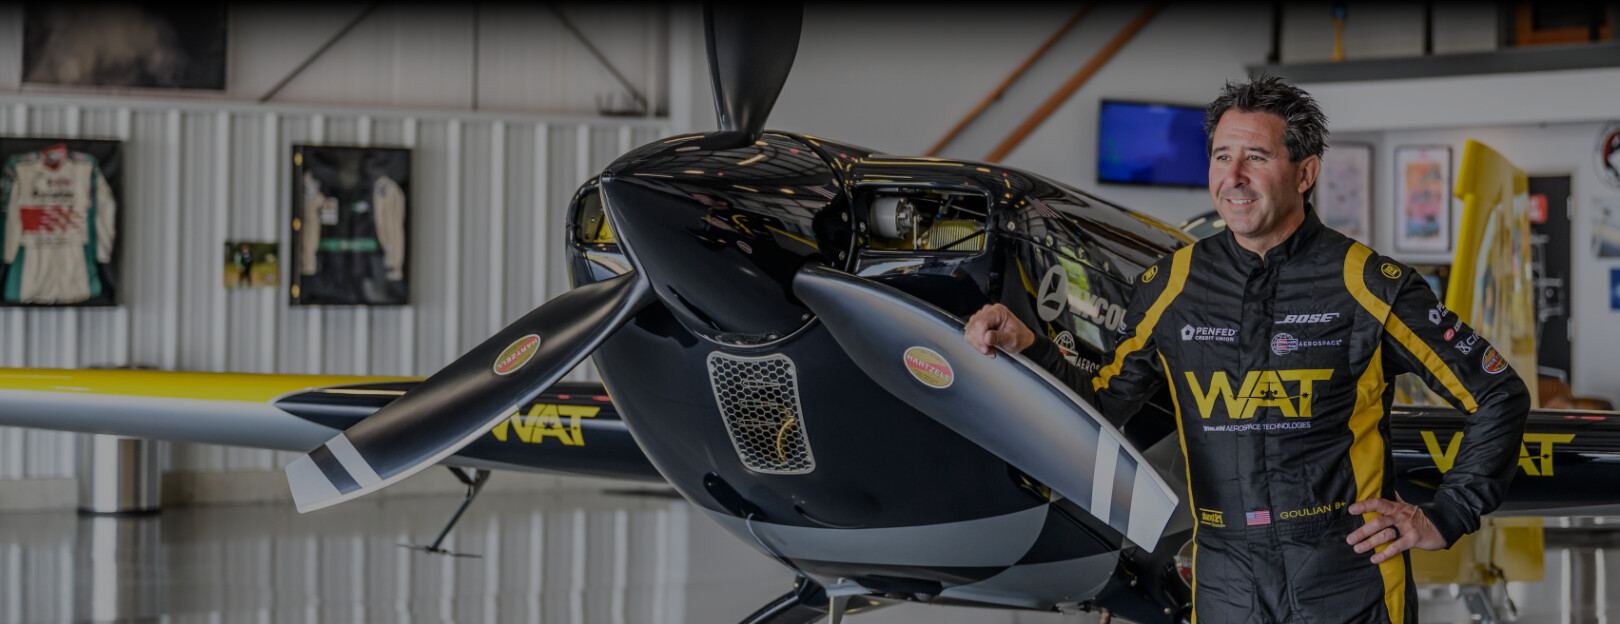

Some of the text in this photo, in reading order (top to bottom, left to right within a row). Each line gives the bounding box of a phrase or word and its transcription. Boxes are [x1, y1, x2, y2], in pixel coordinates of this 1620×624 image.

[1196, 327, 1236, 337] PENFED
[1275, 312, 1341, 325] BOSE
[497, 339, 538, 369] HARTZELL
[906, 353, 950, 382] HARTZELL
[1184, 369, 1335, 419] WAT
[491, 403, 601, 446] WAT
[1226, 423, 1261, 432] AEROSPACE
[1262, 421, 1311, 431] TECHNOLOGIES
[1420, 430, 1576, 477] WT
[1280, 505, 1332, 520] GOULIAN
